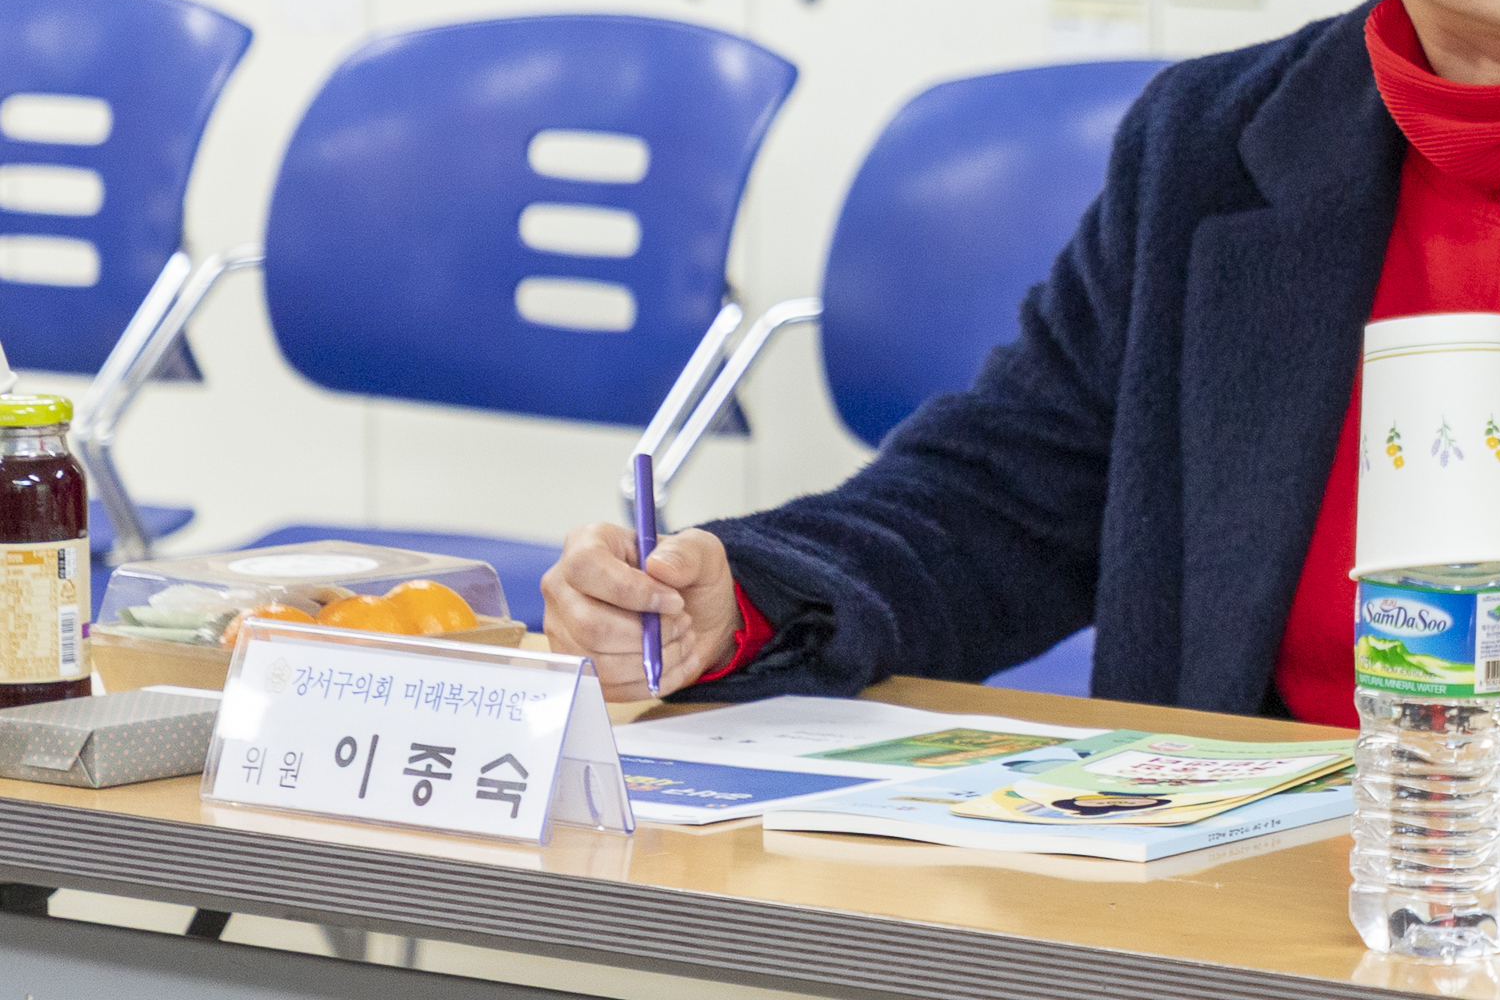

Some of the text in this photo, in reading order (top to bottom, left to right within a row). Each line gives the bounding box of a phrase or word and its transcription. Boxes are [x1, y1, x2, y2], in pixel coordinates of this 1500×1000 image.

[1364, 601, 1447, 633] SamDaSoo
[292, 666, 547, 722] 강서구의회 미래복지위원
[1385, 678, 1416, 692] MINERAL
[1417, 682, 1447, 694] WATER
